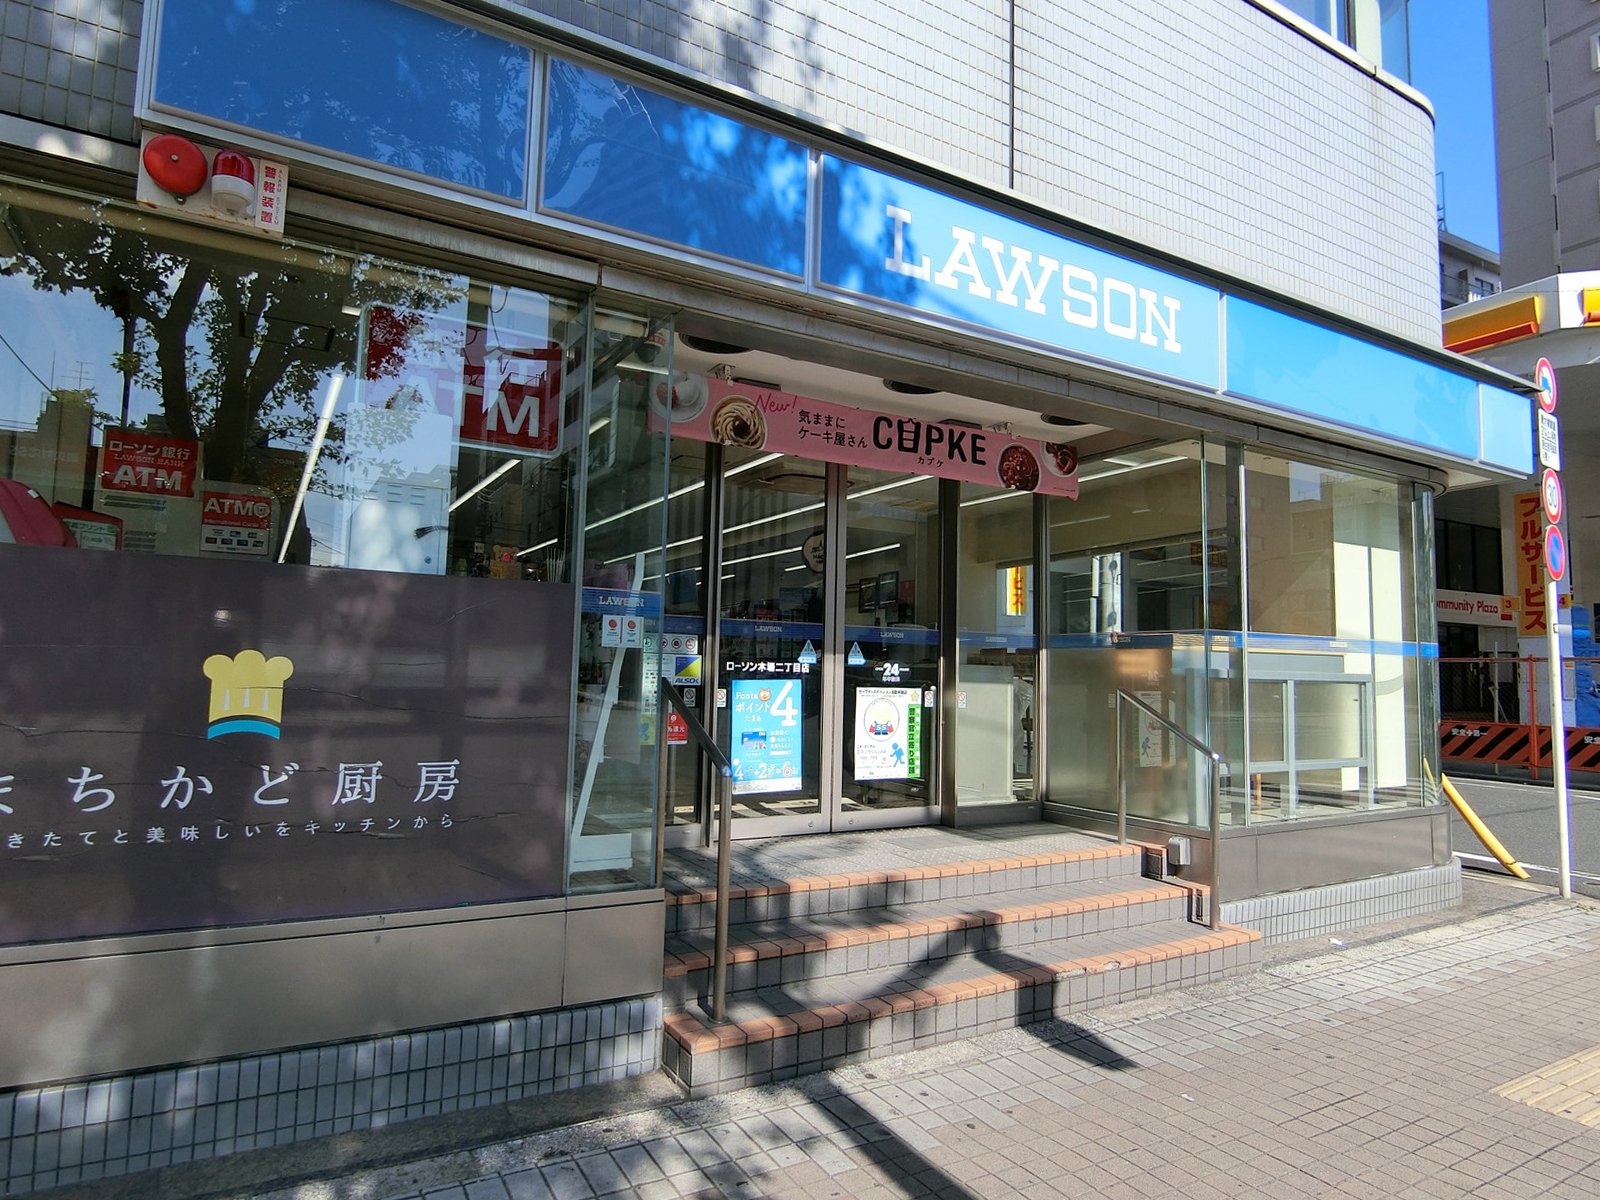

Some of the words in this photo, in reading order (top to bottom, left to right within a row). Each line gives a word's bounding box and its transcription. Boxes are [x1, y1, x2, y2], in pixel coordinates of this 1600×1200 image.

[261, 166, 276, 223] 警報装置
[885, 204, 1182, 354] LAWSON
[388, 374, 540, 438] ATM
[752, 392, 798, 415] New!
[798, 408, 846, 430] 気ままに
[798, 428, 868, 449] ケーキ屋さん
[872, 415, 987, 466] CUPKE
[109, 440, 191, 460] ローソン銀行
[114, 453, 156, 465] LAWSON
[156, 457, 185, 468] BANK
[916, 455, 944, 468] カプケ
[112, 464, 182, 491] ATM
[203, 497, 253, 516] ATM
[1520, 496, 1548, 632] フルサービス
[598, 596, 645, 607] LAWSN
[1436, 599, 1474, 614] mmunity
[1476, 601, 1499, 614] Plaza
[1505, 600, 1512, 608] 3
[1558, 596, 1566, 607] 4
[754, 625, 783, 633] LAWSON
[726, 661, 810, 674] ローソン木場二丁目店
[883, 662, 900, 676] 24
[735, 691, 759, 700] Ponta
[770, 680, 799, 727] 4
[735, 701, 770, 713] ポイント
[7, 813, 453, 849] きたてと美味しいをキッチンから
